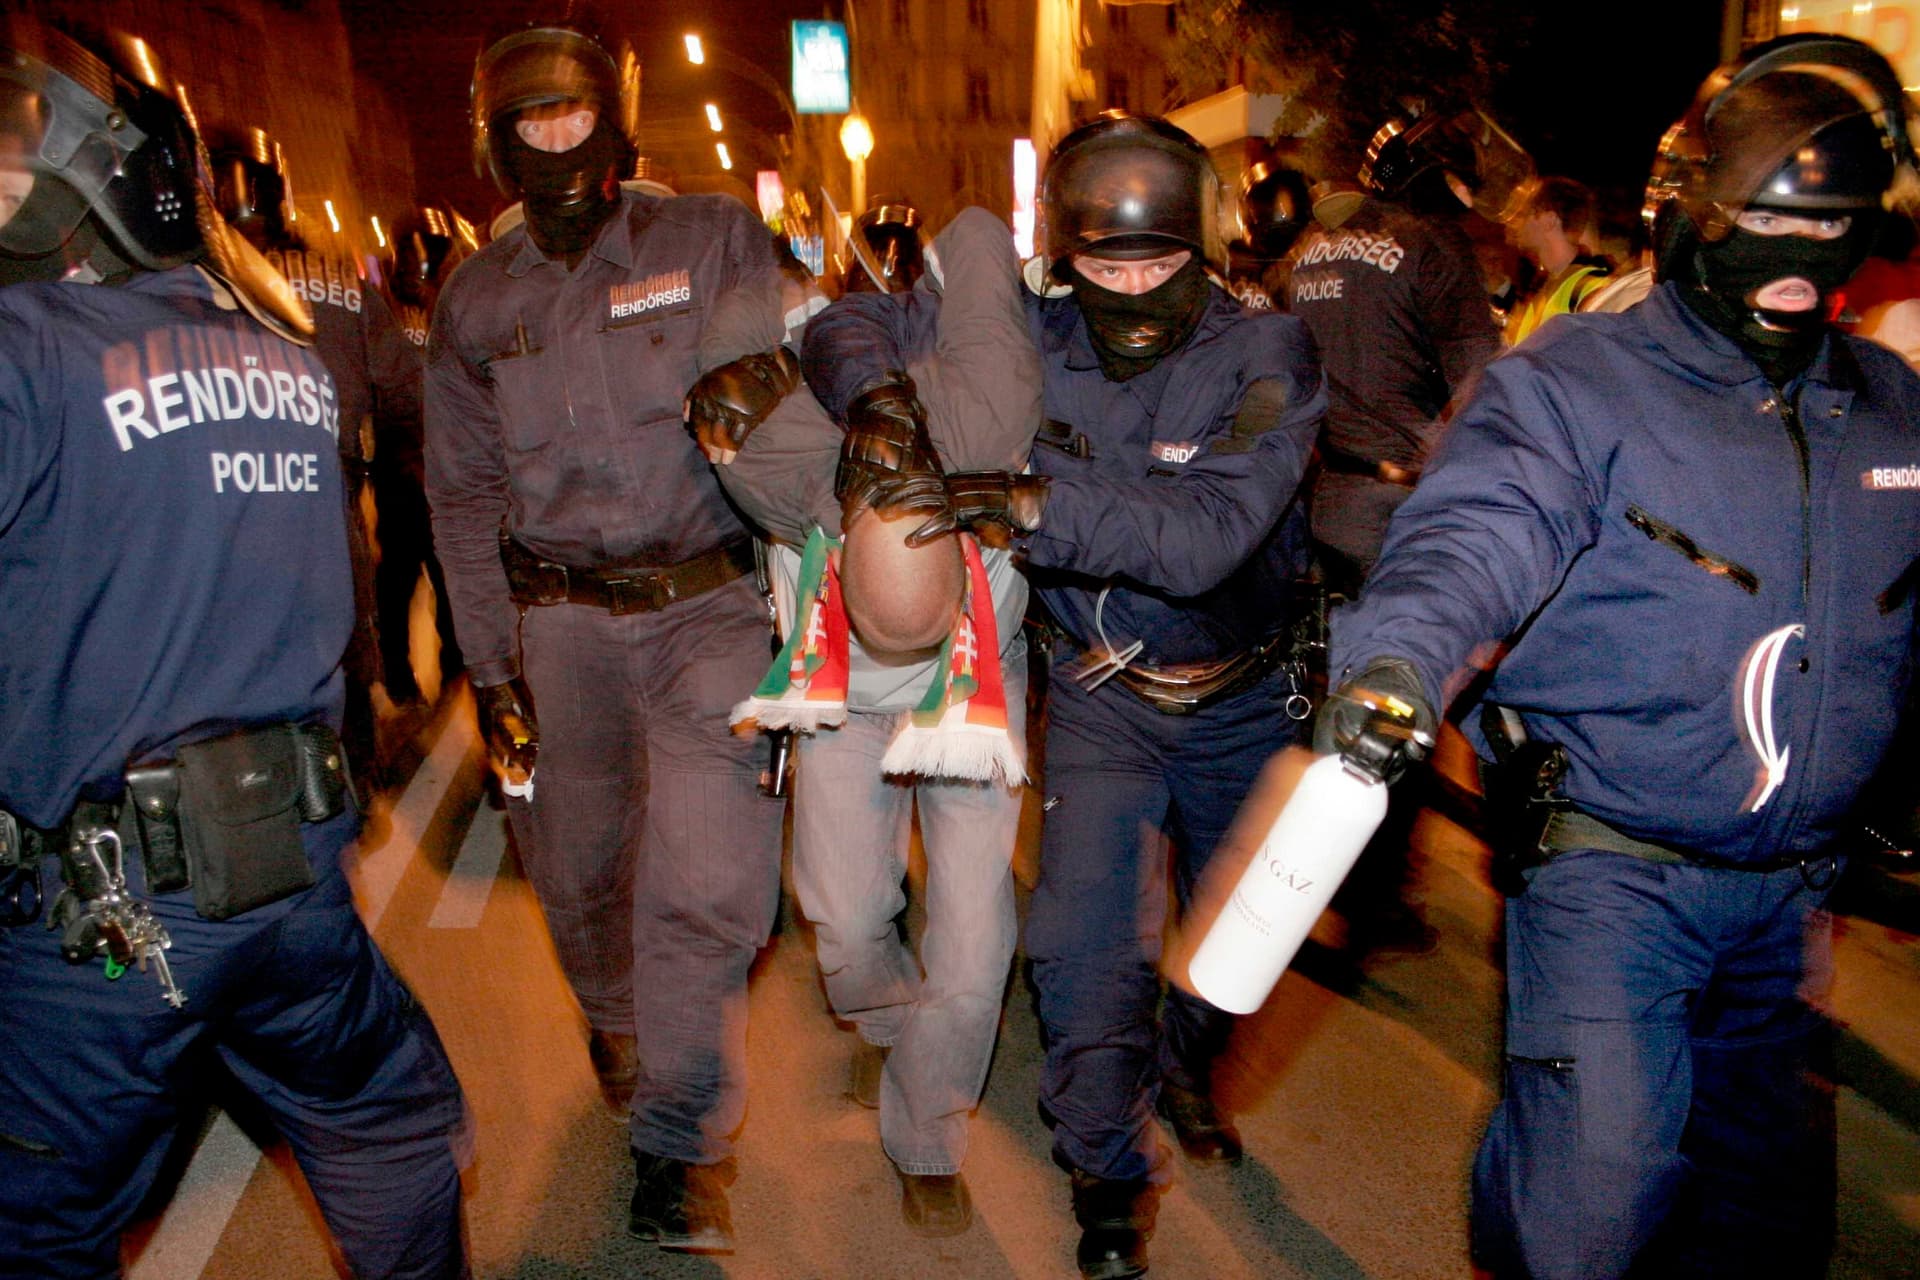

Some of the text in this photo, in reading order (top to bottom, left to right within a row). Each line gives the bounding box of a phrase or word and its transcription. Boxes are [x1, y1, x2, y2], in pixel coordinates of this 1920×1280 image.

[1293, 236, 1404, 274] NDŐRSÉG
[611, 286, 690, 318] RENDŐRSÉG
[1297, 279, 1344, 303] POLICE
[211, 452, 319, 493] POLICE
[1872, 464, 1920, 488] RENDŐ
